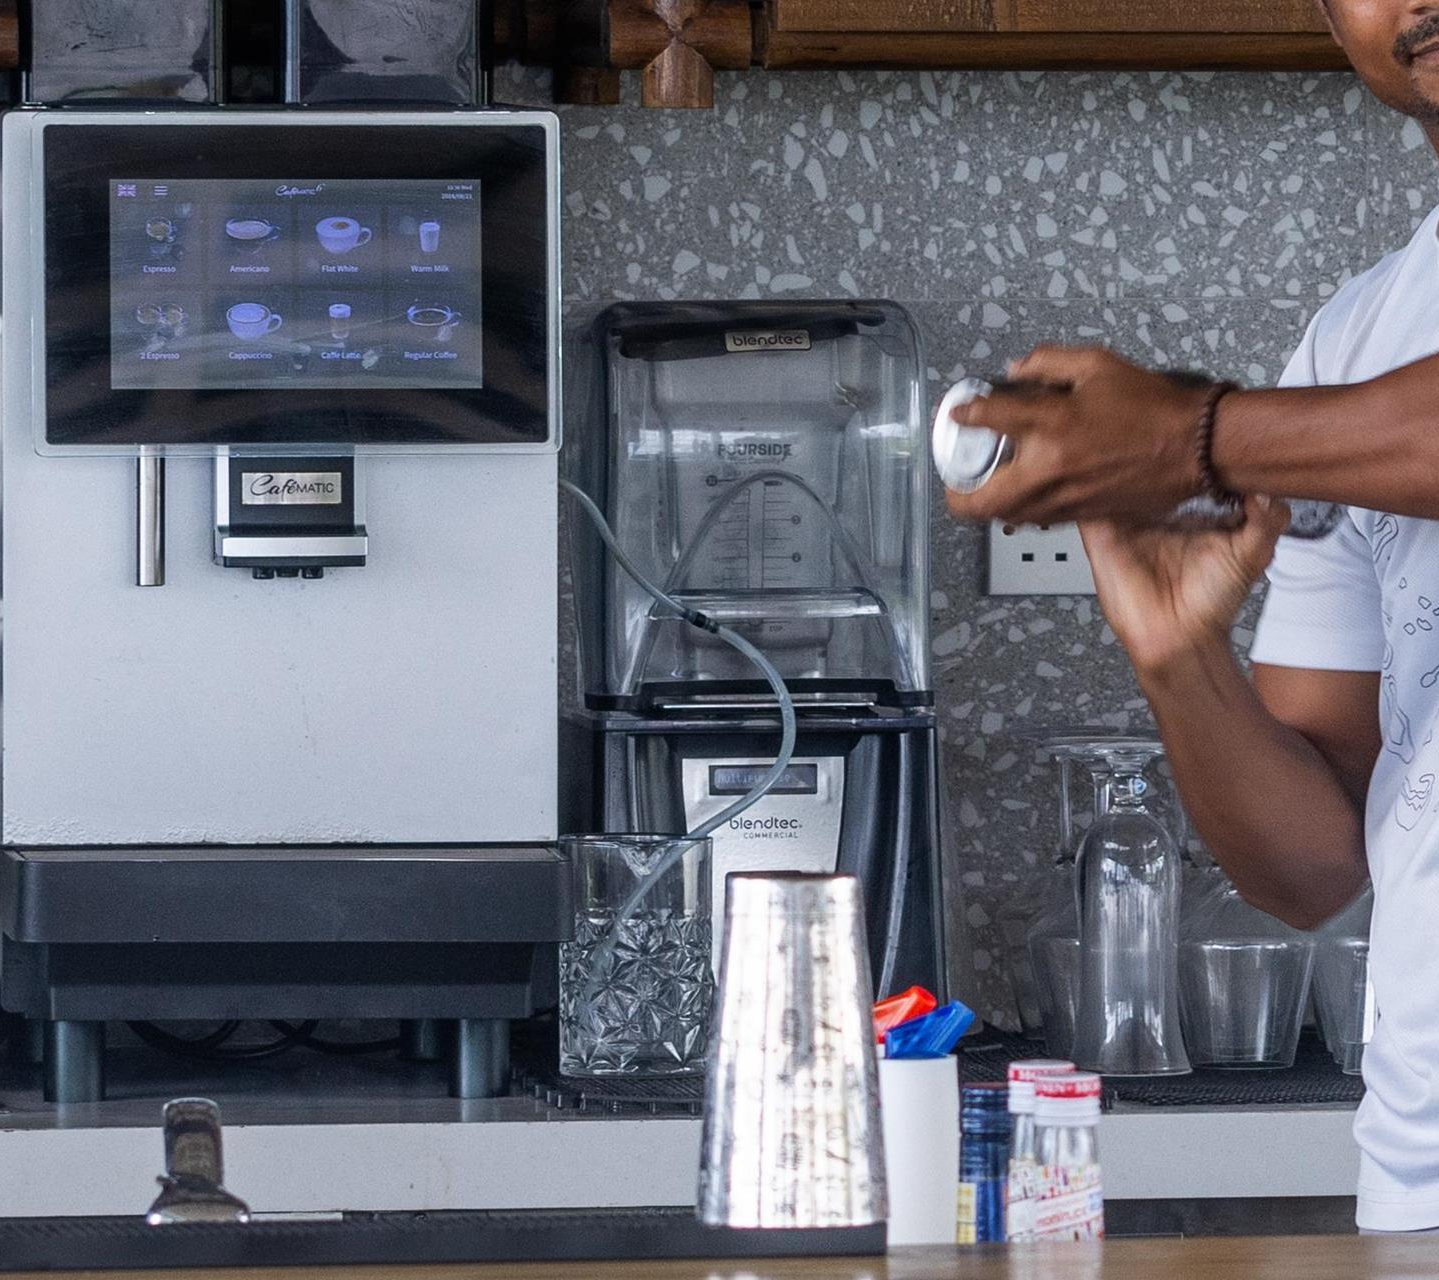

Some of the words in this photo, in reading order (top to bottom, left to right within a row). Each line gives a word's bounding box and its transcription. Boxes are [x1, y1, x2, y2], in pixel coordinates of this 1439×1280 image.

[143, 265, 177, 276] Espresso
[229, 264, 270, 273] Americano
[321, 264, 335, 273] Flat
[336, 264, 360, 273] White
[410, 264, 434, 273] Warm
[435, 264, 450, 273] Milk
[731, 332, 804, 348] blendtec
[147, 351, 181, 363] Espresso
[228, 351, 273, 363] Cappuccino
[404, 350, 433, 363] Regular
[433, 350, 458, 361] Coffee
[729, 816, 803, 830] blendtec
[743, 831, 799, 839] COMMERCIAL
